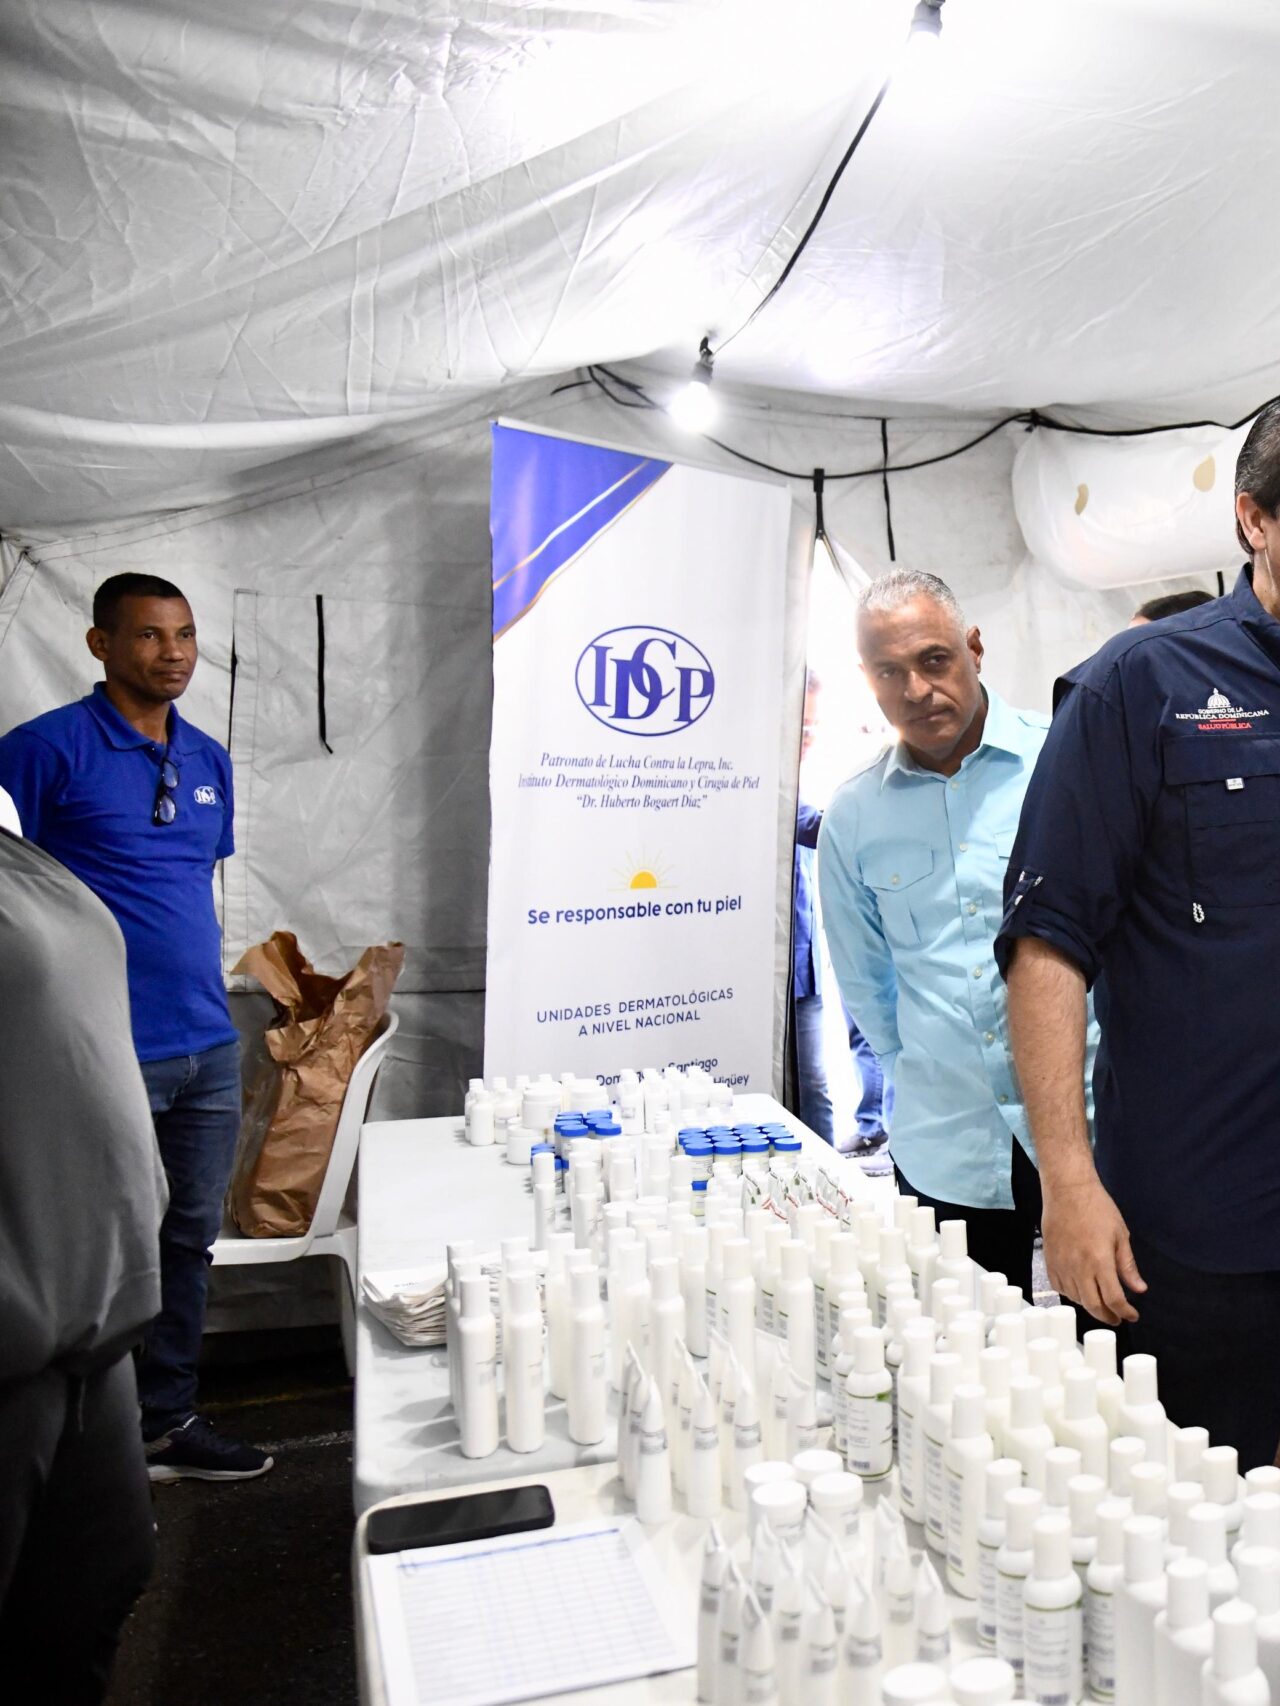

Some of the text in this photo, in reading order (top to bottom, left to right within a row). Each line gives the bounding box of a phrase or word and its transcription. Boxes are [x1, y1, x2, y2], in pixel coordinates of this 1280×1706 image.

[1218, 709, 1270, 719] DOMINICANA
[540, 752, 734, 773] Patronato de Lucha Contra la Lepra, Inc.
[555, 773, 629, 791] Dermatológico
[631, 775, 689, 789] Dominicano
[688, 779, 696, 792] y
[730, 776, 741, 789] de
[742, 776, 760, 789] Piel
[600, 794, 640, 808] Huberto
[643, 794, 679, 811] Bogaert
[528, 895, 742, 925] Se responsable con tu piel
[536, 988, 734, 1023] UNIDADES DERMATOLÓGICAS
[578, 1010, 701, 1037] A NIVEL NACIONAL
